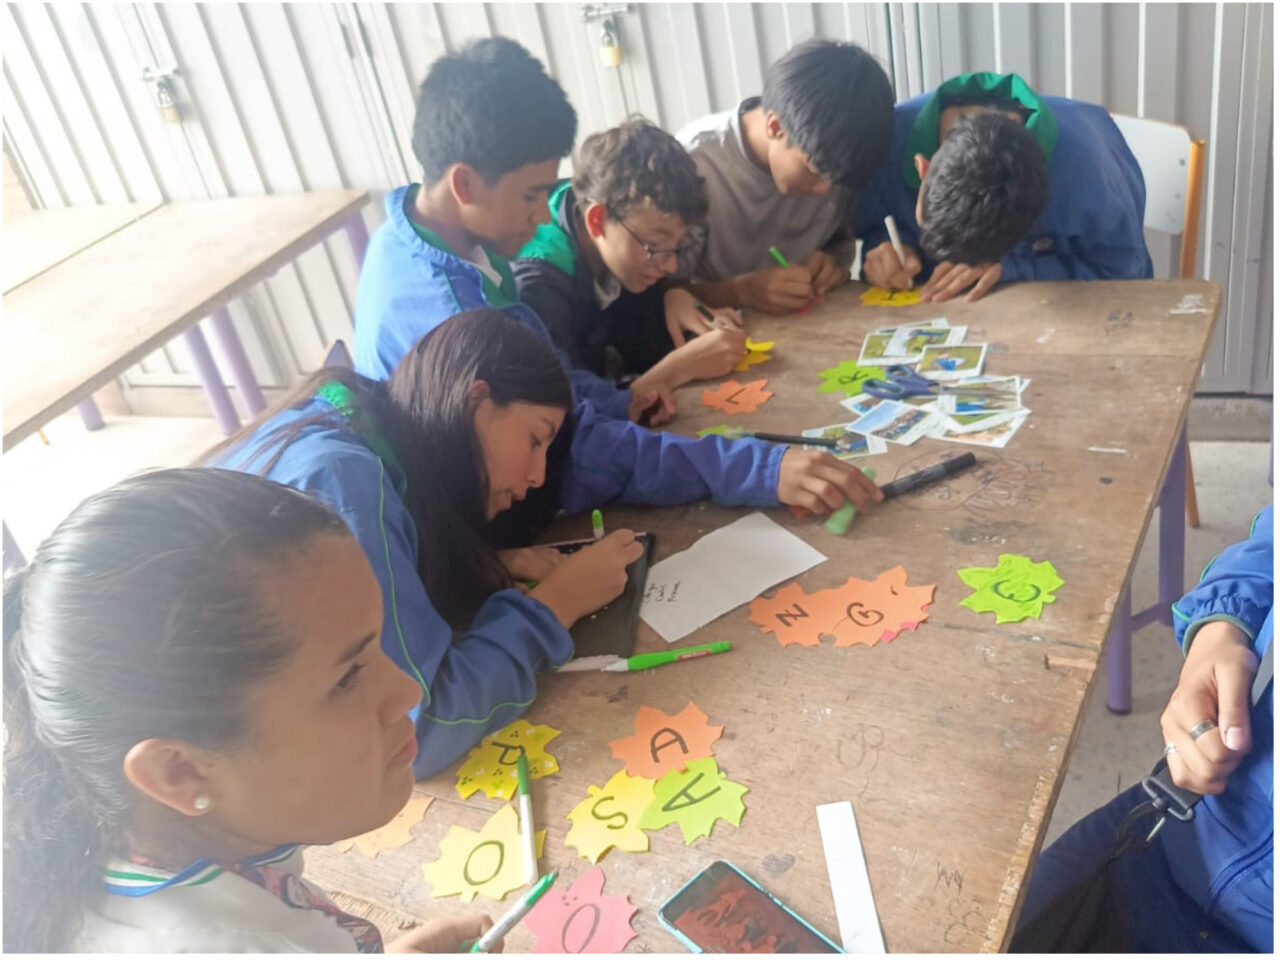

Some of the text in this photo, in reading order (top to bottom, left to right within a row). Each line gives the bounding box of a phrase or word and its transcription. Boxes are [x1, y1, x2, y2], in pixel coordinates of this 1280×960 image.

[651, 728, 689, 763] A
[661, 772, 722, 812] A
[591, 796, 628, 830] S
[463, 840, 505, 886] O
